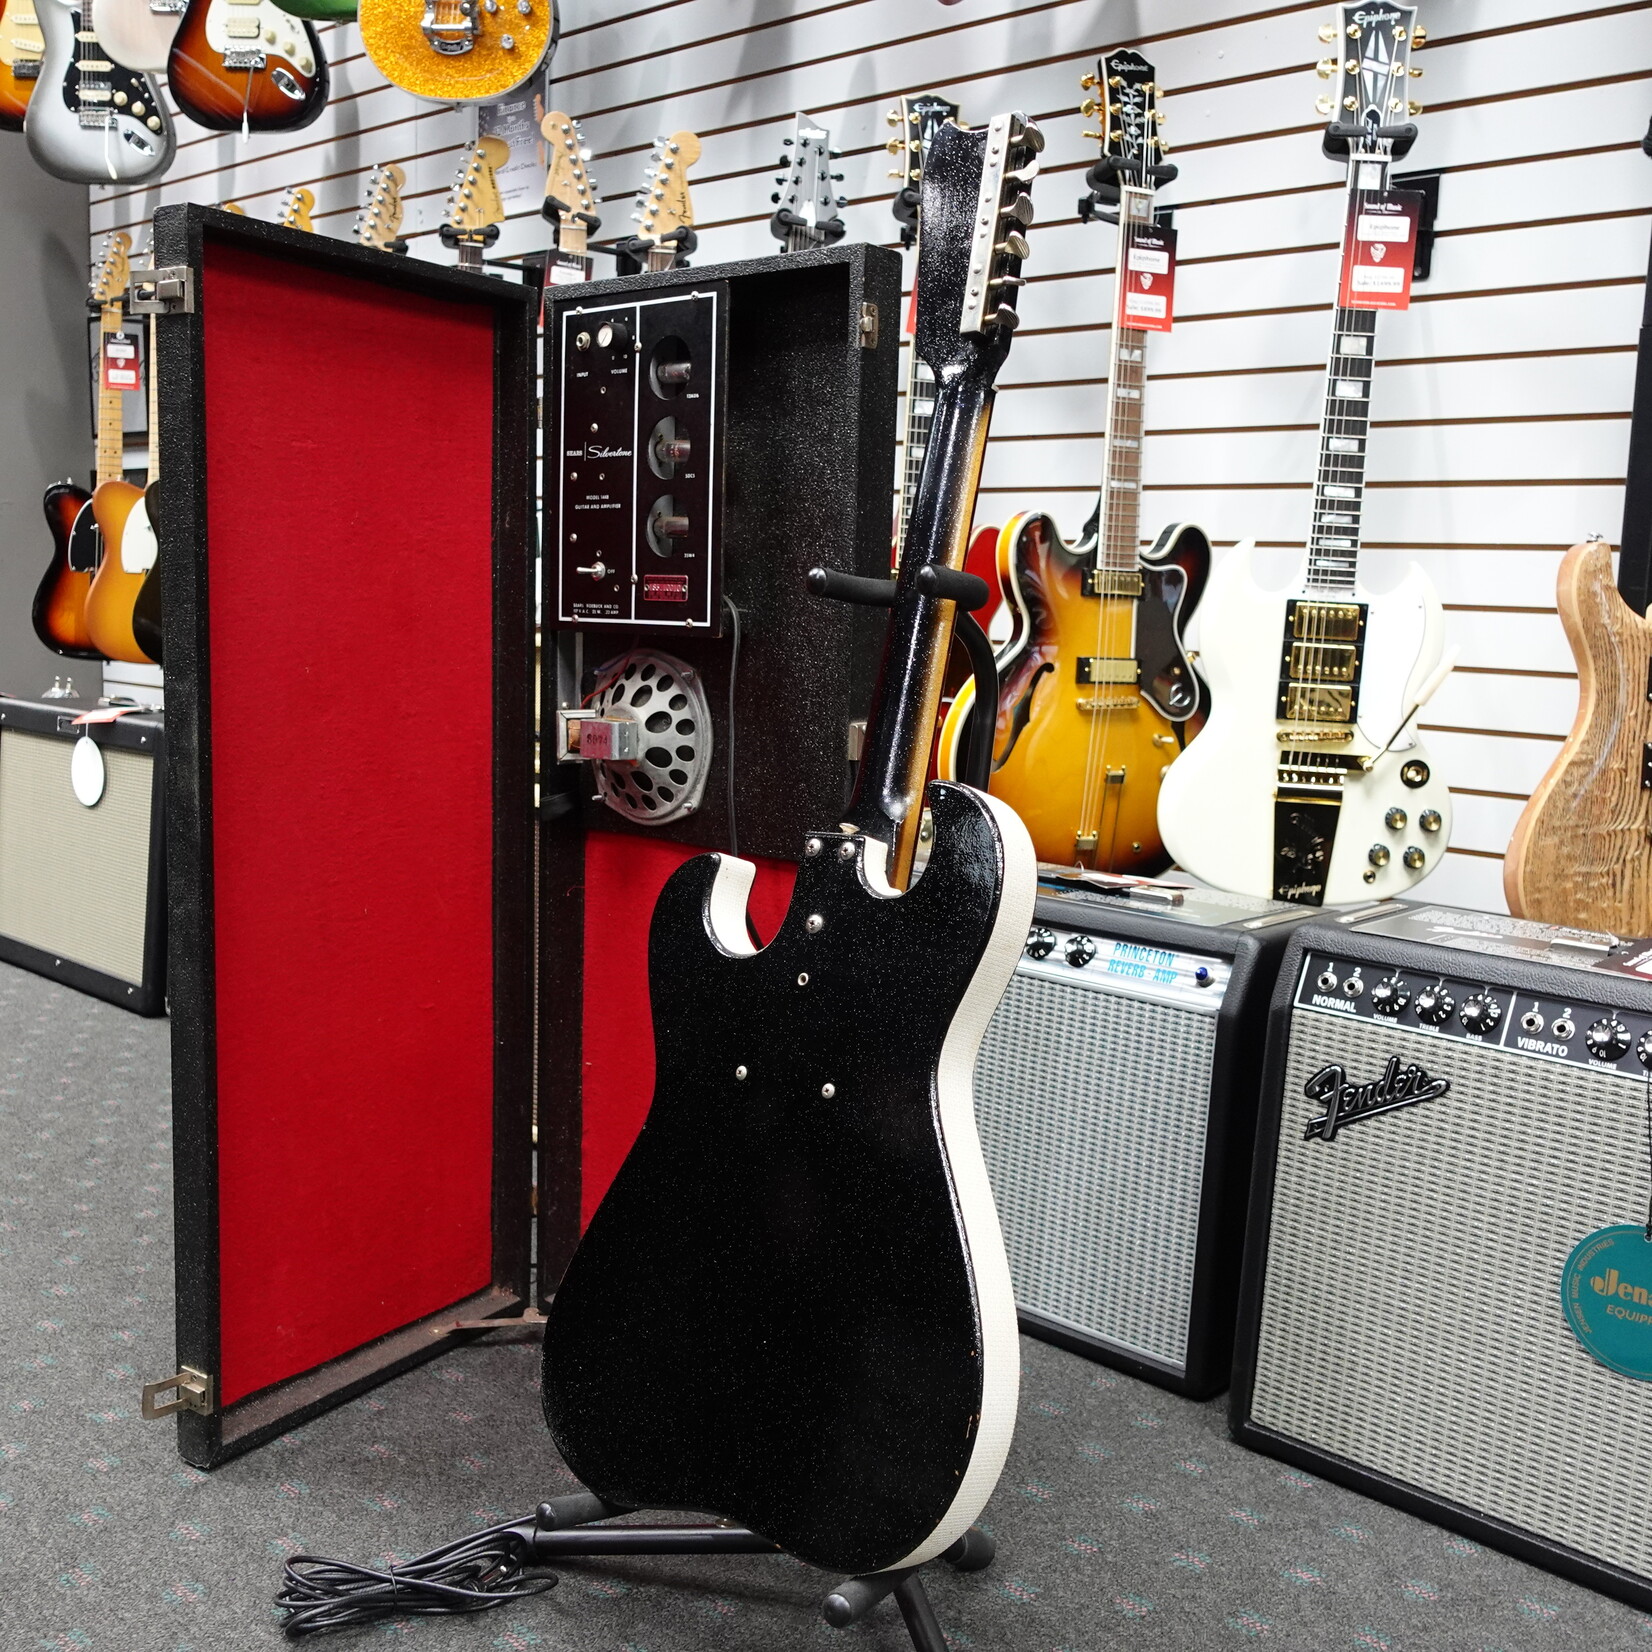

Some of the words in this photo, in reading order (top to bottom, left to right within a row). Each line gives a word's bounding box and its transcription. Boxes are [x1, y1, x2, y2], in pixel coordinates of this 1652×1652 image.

[1352, 8, 1402, 28] Epiphone
[675, 191, 691, 224] Fender
[587, 445, 632, 459] Silvertone
[1113, 942, 1175, 967] PRINCETON
[1327, 962, 1334, 972] 1
[1353, 967, 1362, 977] 2
[1312, 994, 1357, 1013] NORMAL
[1532, 1001, 1540, 1013] 1
[1562, 1007, 1572, 1018] 2
[1373, 1013, 1398, 1024] VOLUME
[1419, 1023, 1440, 1032] TREBLE
[1466, 1033, 1483, 1041] BASS
[1517, 1036, 1569, 1057] VIBRATO
[1588, 1058, 1618, 1070] VOLUME
[1305, 1056, 1450, 1140] Fender
[1571, 1273, 1581, 1299] MUSIC
[1577, 1239, 1615, 1272] INDUSTRIES
